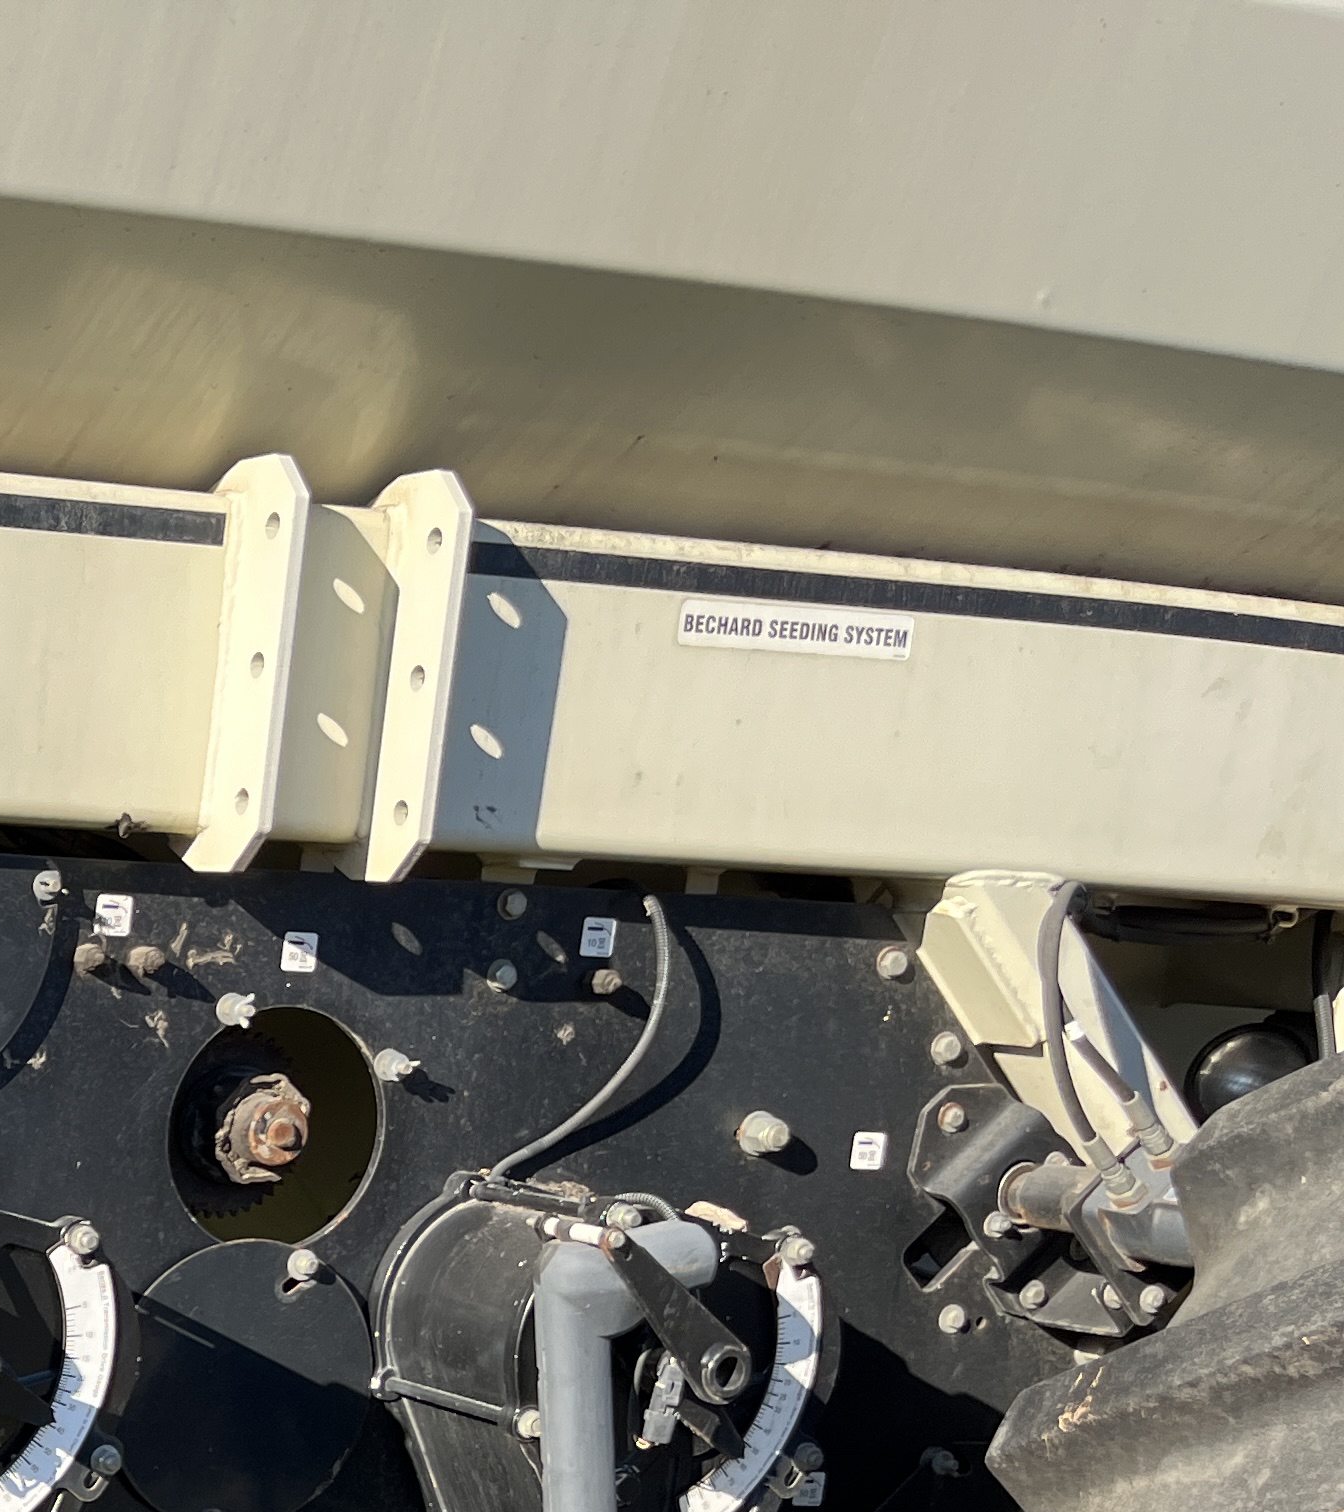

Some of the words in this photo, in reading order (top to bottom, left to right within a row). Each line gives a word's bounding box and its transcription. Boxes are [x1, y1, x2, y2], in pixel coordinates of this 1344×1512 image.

[684, 613, 762, 637] BECHARD
[768, 619, 839, 642] SEEDING
[844, 625, 908, 649] SYSTEM
[588, 938, 597, 947] 10
